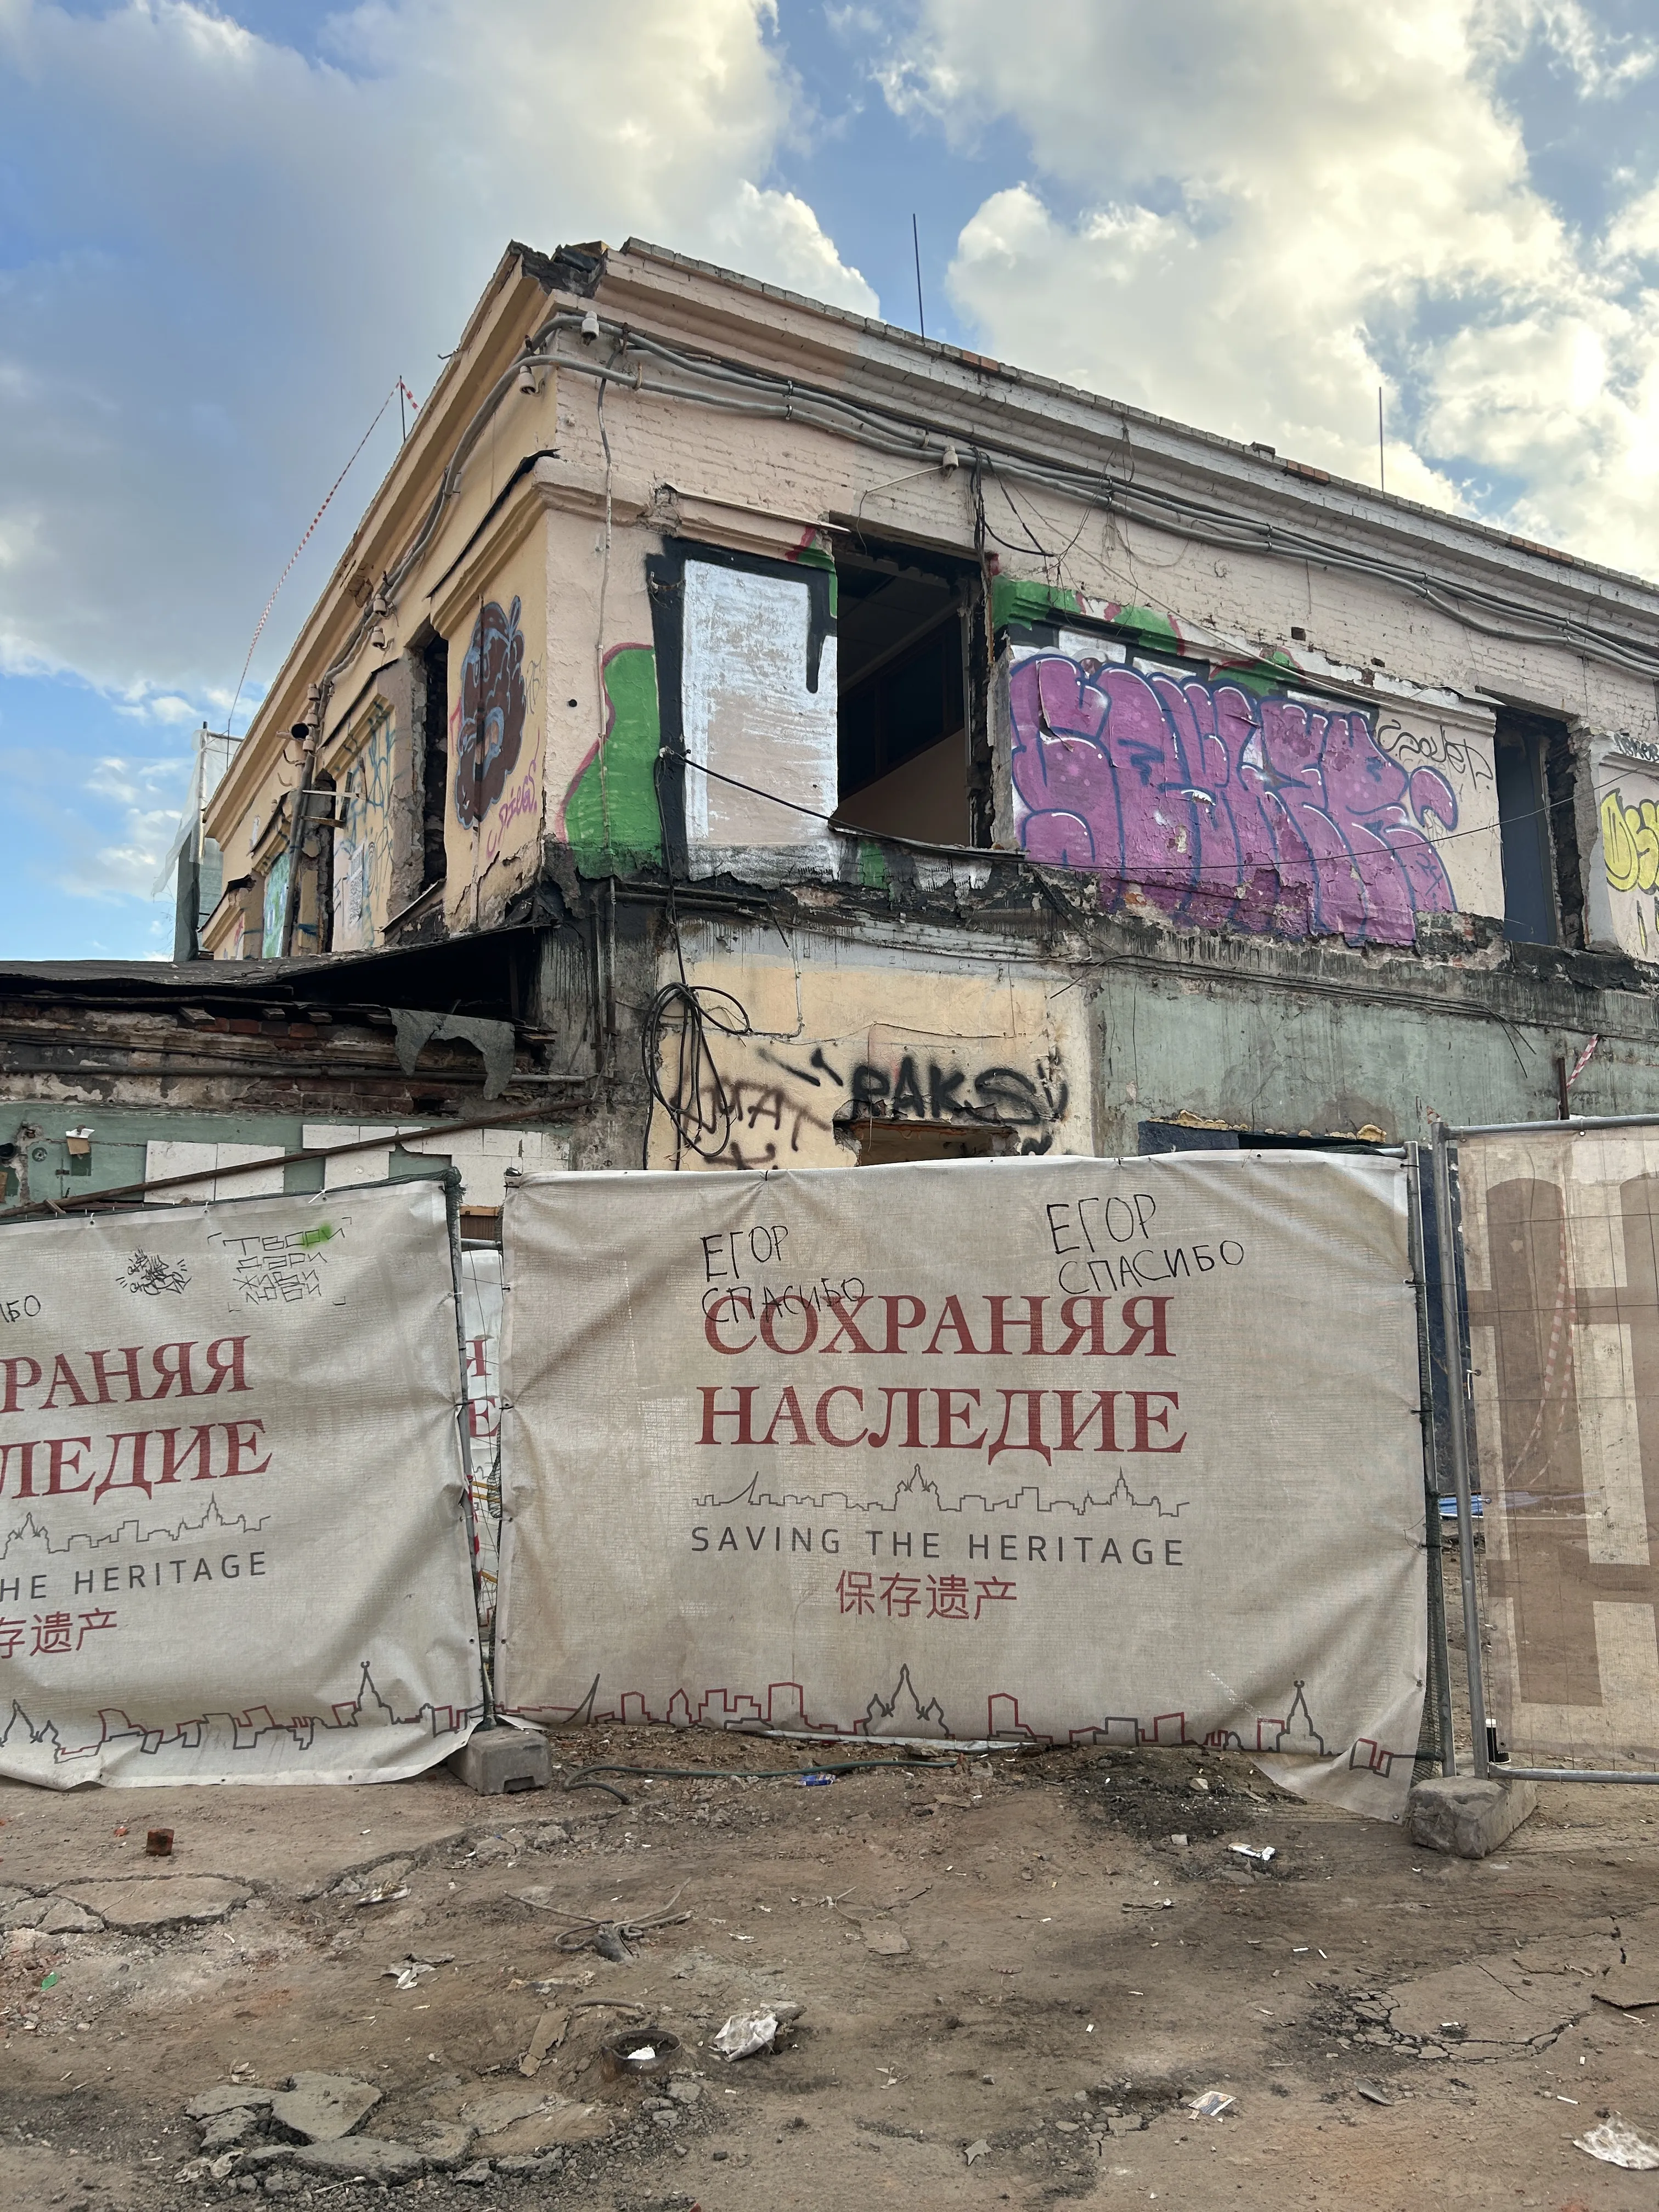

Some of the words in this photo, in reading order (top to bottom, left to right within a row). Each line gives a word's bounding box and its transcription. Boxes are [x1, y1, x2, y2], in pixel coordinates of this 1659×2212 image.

[1046, 1194, 1156, 1255] ЕГОР
[699, 1225, 788, 1283] ЕГОР
[1058, 1240, 1244, 1294] СПАСИБО
[702, 1277, 865, 1323] СПАСИБО
[704, 1294, 1177, 1358] СОХРАНЯЯ
[694, 1385, 1188, 1467] НАСЛЕДИЕ
[75, 1551, 266, 1595] HERITAGE
[691, 1526, 840, 1555] SAVING
[865, 1530, 940, 1559] THE
[968, 1534, 1183, 1567] HERITAGE
[835, 1568, 1018, 1621] 保存遗产
